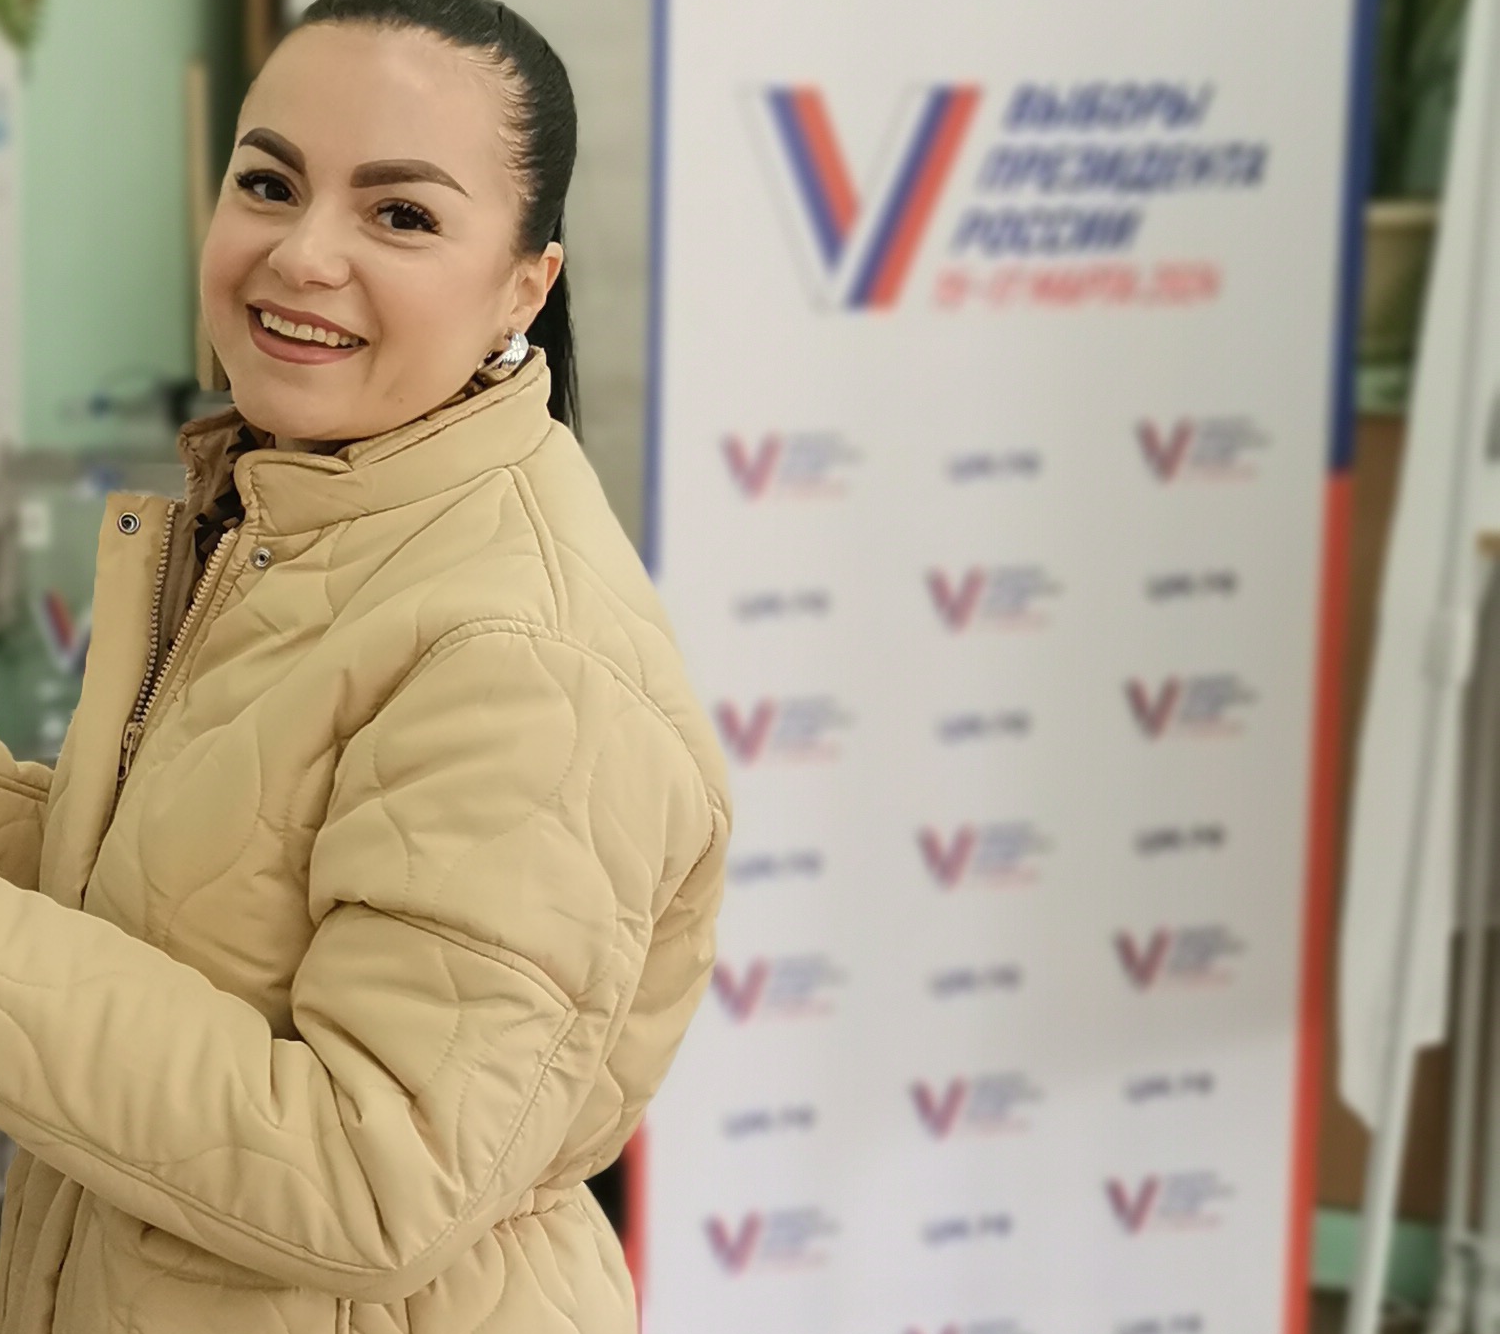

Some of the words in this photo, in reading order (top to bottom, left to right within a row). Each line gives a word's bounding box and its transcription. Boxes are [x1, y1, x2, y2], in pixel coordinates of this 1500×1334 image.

[1003, 79, 1216, 131] ВЫБОРЫ
[975, 140, 1269, 193] ПРЕЗИДЕНТА
[949, 204, 1144, 256] РОССИИ
